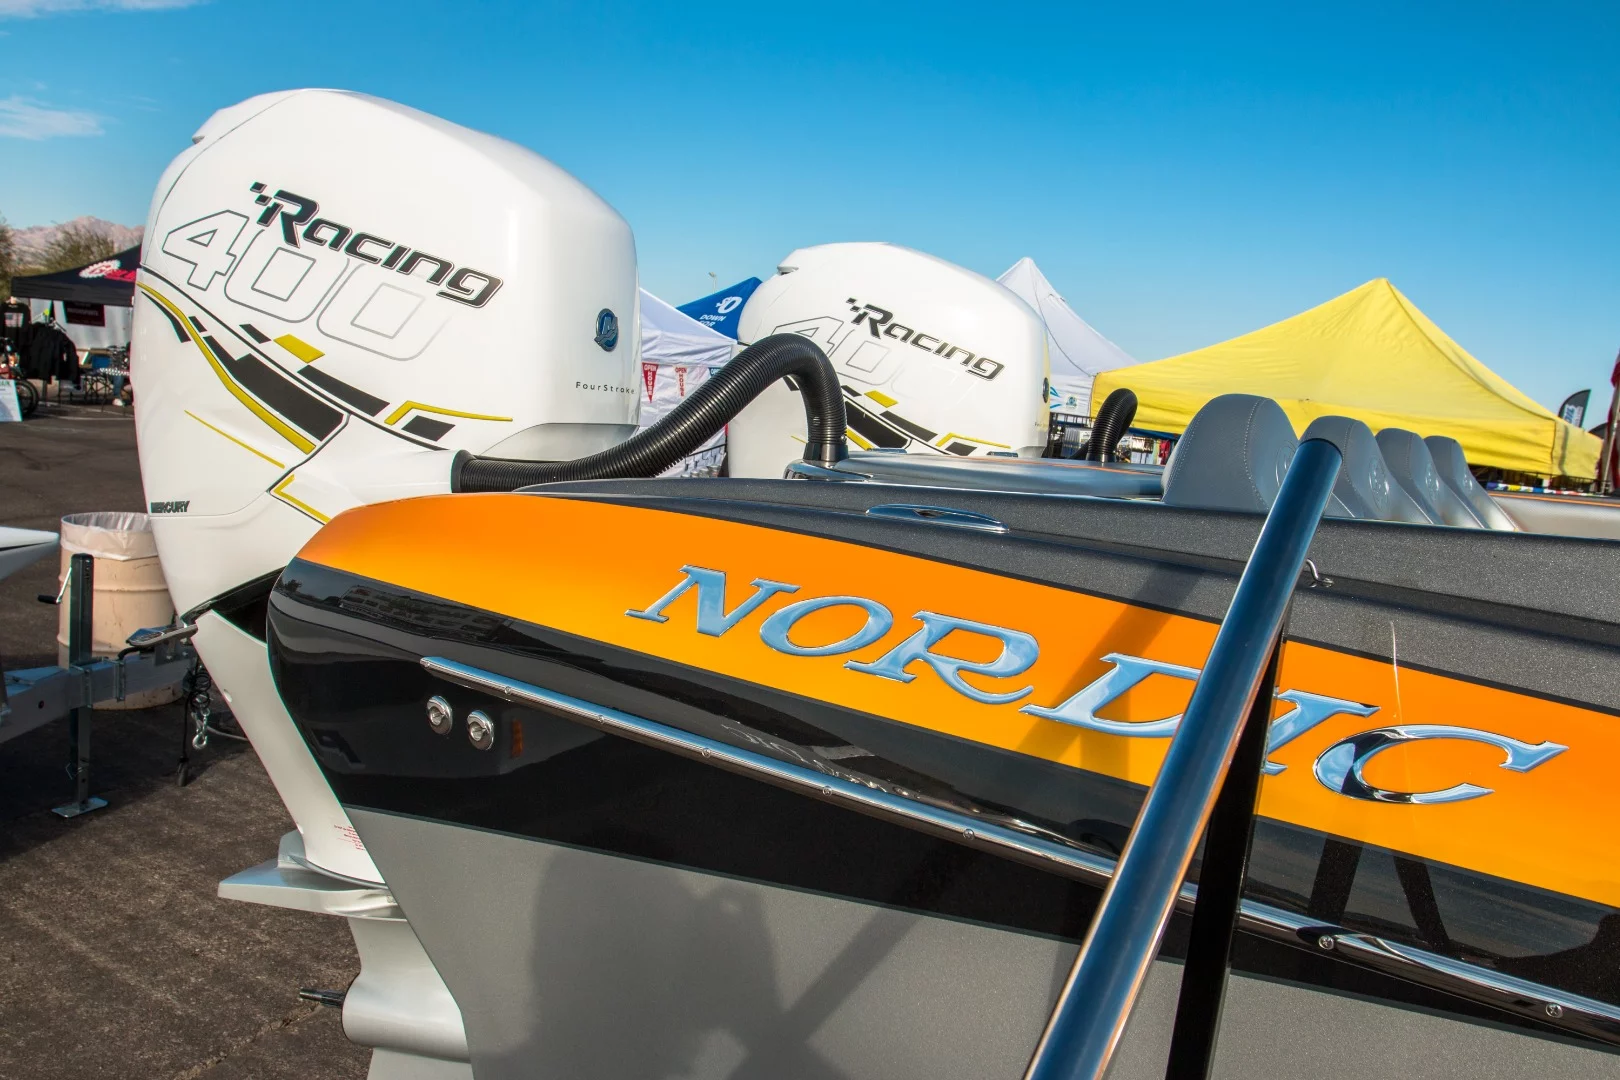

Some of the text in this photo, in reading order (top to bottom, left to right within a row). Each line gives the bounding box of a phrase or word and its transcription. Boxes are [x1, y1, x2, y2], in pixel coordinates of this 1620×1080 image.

[162, 209, 453, 361] 400
[250, 181, 504, 309] Racing
[699, 314, 726, 322] DOWN
[846, 297, 1005, 381] Racing
[575, 381, 635, 394] FourStroke
[150, 500, 190, 513] MERCURY
[624, 564, 1570, 805] NORDIC
